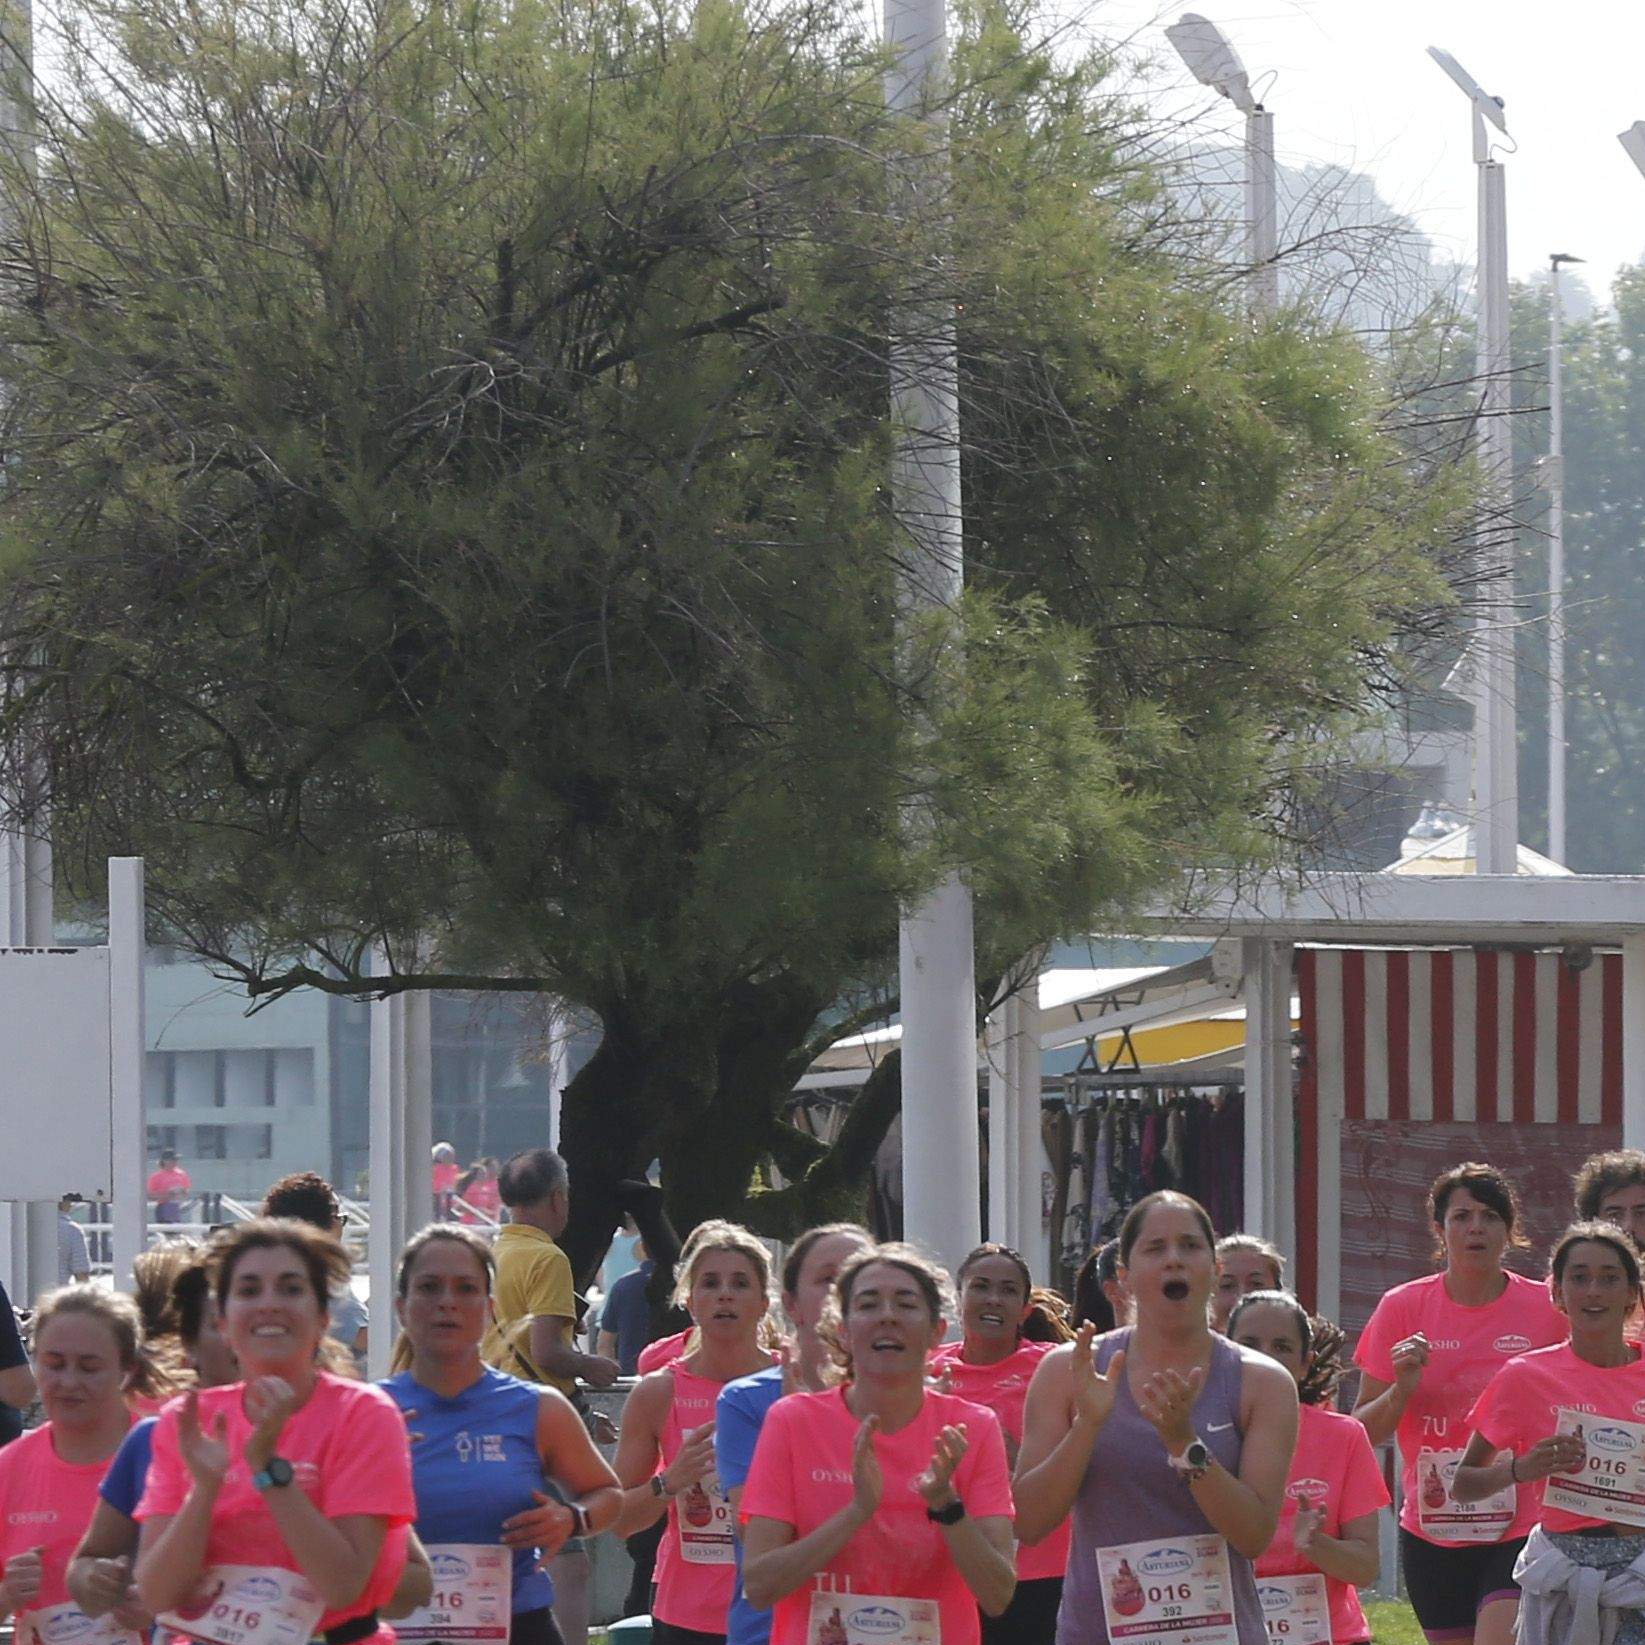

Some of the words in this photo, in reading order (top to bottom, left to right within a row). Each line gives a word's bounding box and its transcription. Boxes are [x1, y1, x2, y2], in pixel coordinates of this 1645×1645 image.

[1589, 1456, 1627, 1475] 016
[1142, 1558, 1190, 1572] ASTURIANA
[434, 1592, 463, 1609] 16
[1148, 1583, 1191, 1602] 016
[213, 1604, 262, 1630] 016
[1162, 1606, 1182, 1617] 392
[854, 1615, 900, 1628] ASTURIANA
[1267, 1619, 1290, 1634] 16
